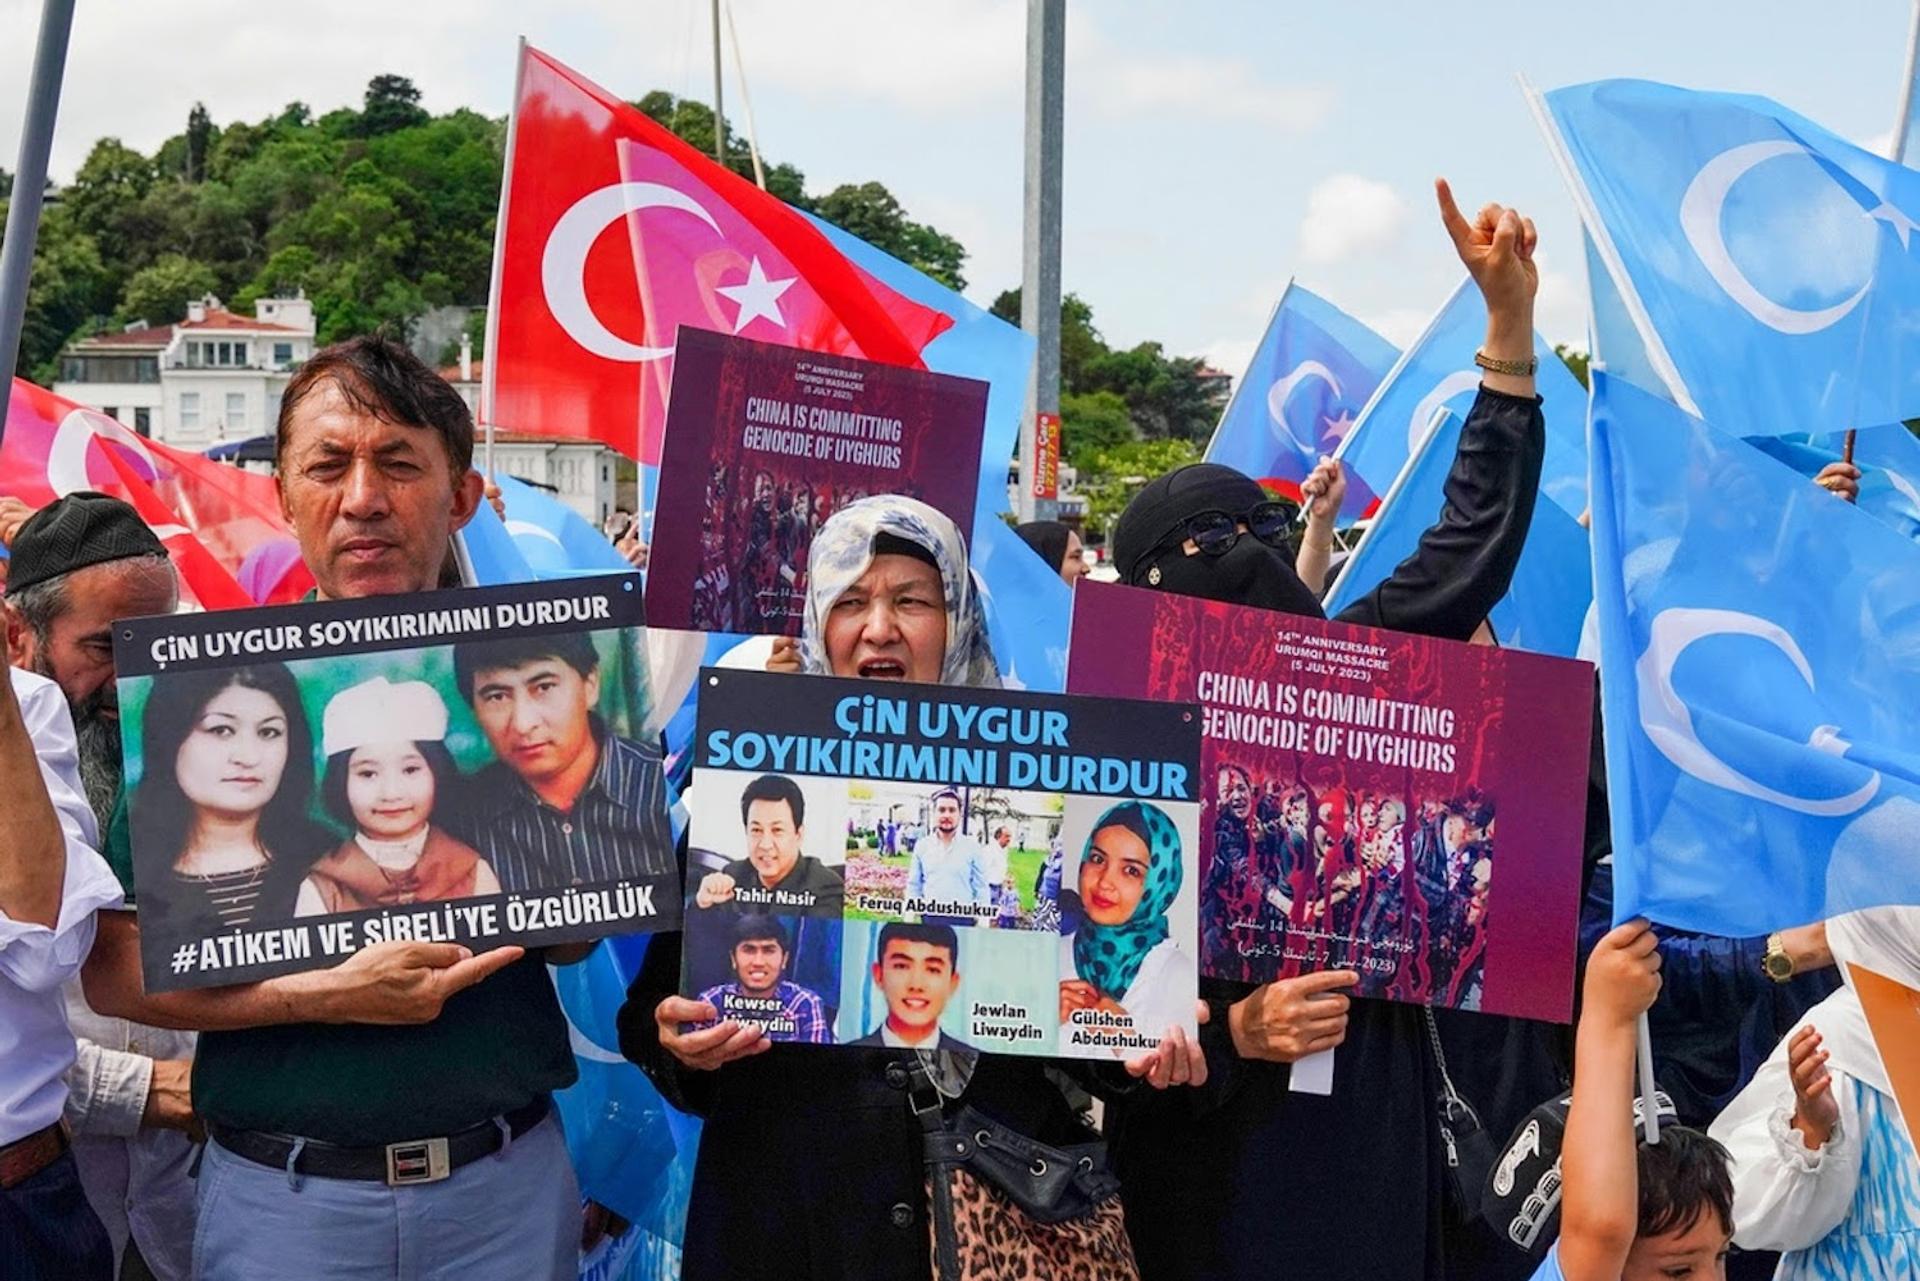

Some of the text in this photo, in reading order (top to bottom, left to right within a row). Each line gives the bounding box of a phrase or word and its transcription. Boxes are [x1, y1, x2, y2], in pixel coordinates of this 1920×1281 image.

[812, 365, 864, 380] ANNIVERSARY
[813, 386, 832, 396] JULY
[825, 378, 865, 392] MASSACRE
[746, 397, 902, 443] CHINA IS COMMITTING
[743, 425, 902, 470] GENOCIDE OF UYGHURS
[204, 625, 304, 657] UYGUR
[309, 606, 492, 647] SOYIKIRIMINI
[496, 595, 611, 629] DURDUR
[1303, 635, 1387, 656] ANNIVERSARY
[1275, 644, 1390, 671] URUMQI MASSACRE
[1291, 659, 1371, 682] (5 JULY 2023)
[1198, 671, 1456, 739] CHINA IS COMMITTING
[919, 701, 1069, 748] UYGUR
[1314, 725, 1345, 757] OF
[1346, 731, 1457, 774] UYGHURS
[707, 729, 1189, 799] SOYIKIRIMINI DURDUR
[735, 887, 817, 906] Tahir Nasir
[859, 895, 999, 918] Feruq Abdushukur
[171, 926, 312, 974] #ATİKEM
[318, 921, 357, 956] VE
[506, 881, 657, 933] ÖZGÜRLÜK
[1268, 919, 1283, 932] 14
[723, 994, 783, 1011] Kewser
[973, 1003, 1026, 1018] Jewlan
[1072, 1012, 1133, 1027] Gülshen
[973, 1023, 1042, 1041] Liwaydin
